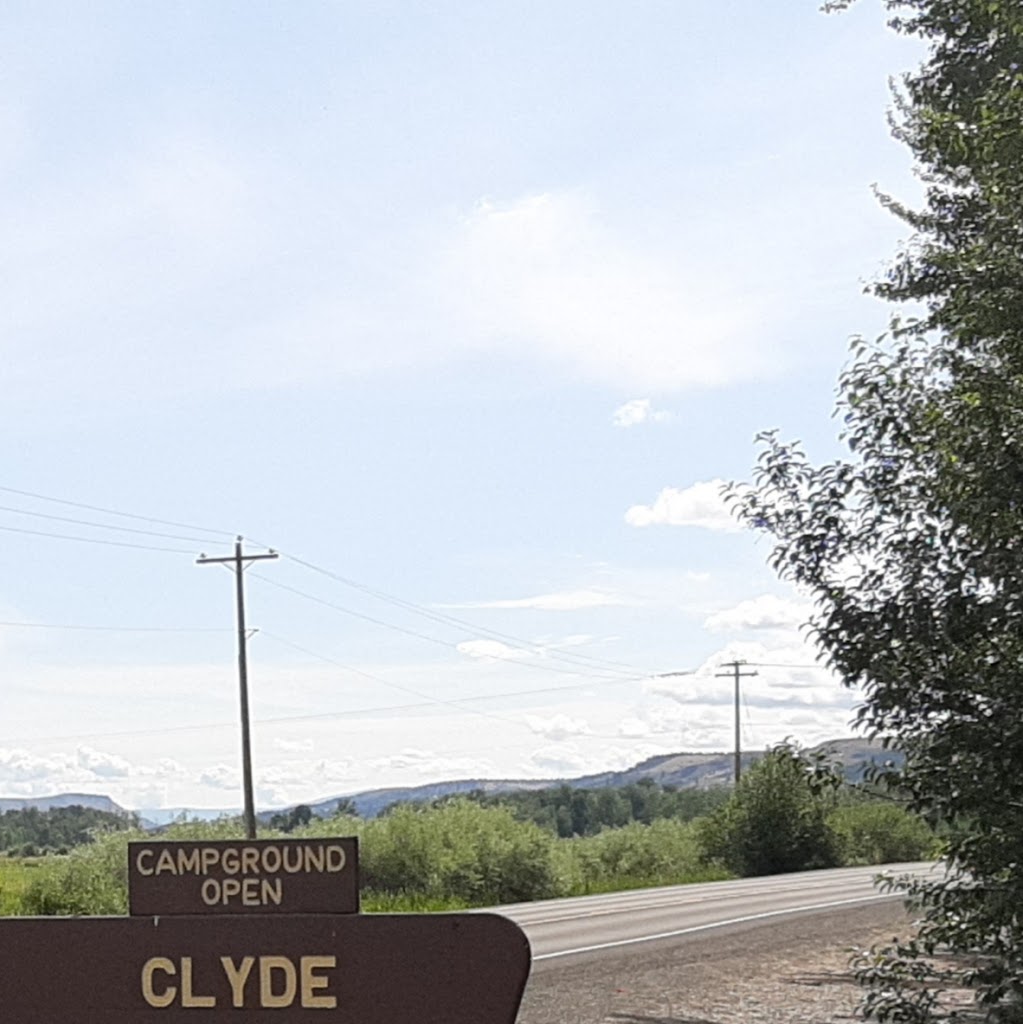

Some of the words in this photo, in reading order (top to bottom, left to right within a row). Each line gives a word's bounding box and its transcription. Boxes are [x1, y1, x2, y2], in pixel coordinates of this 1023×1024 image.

[136, 845, 347, 877] CAMPGROUND
[201, 878, 283, 906] OPEN
[141, 955, 338, 1009] CLYDE
